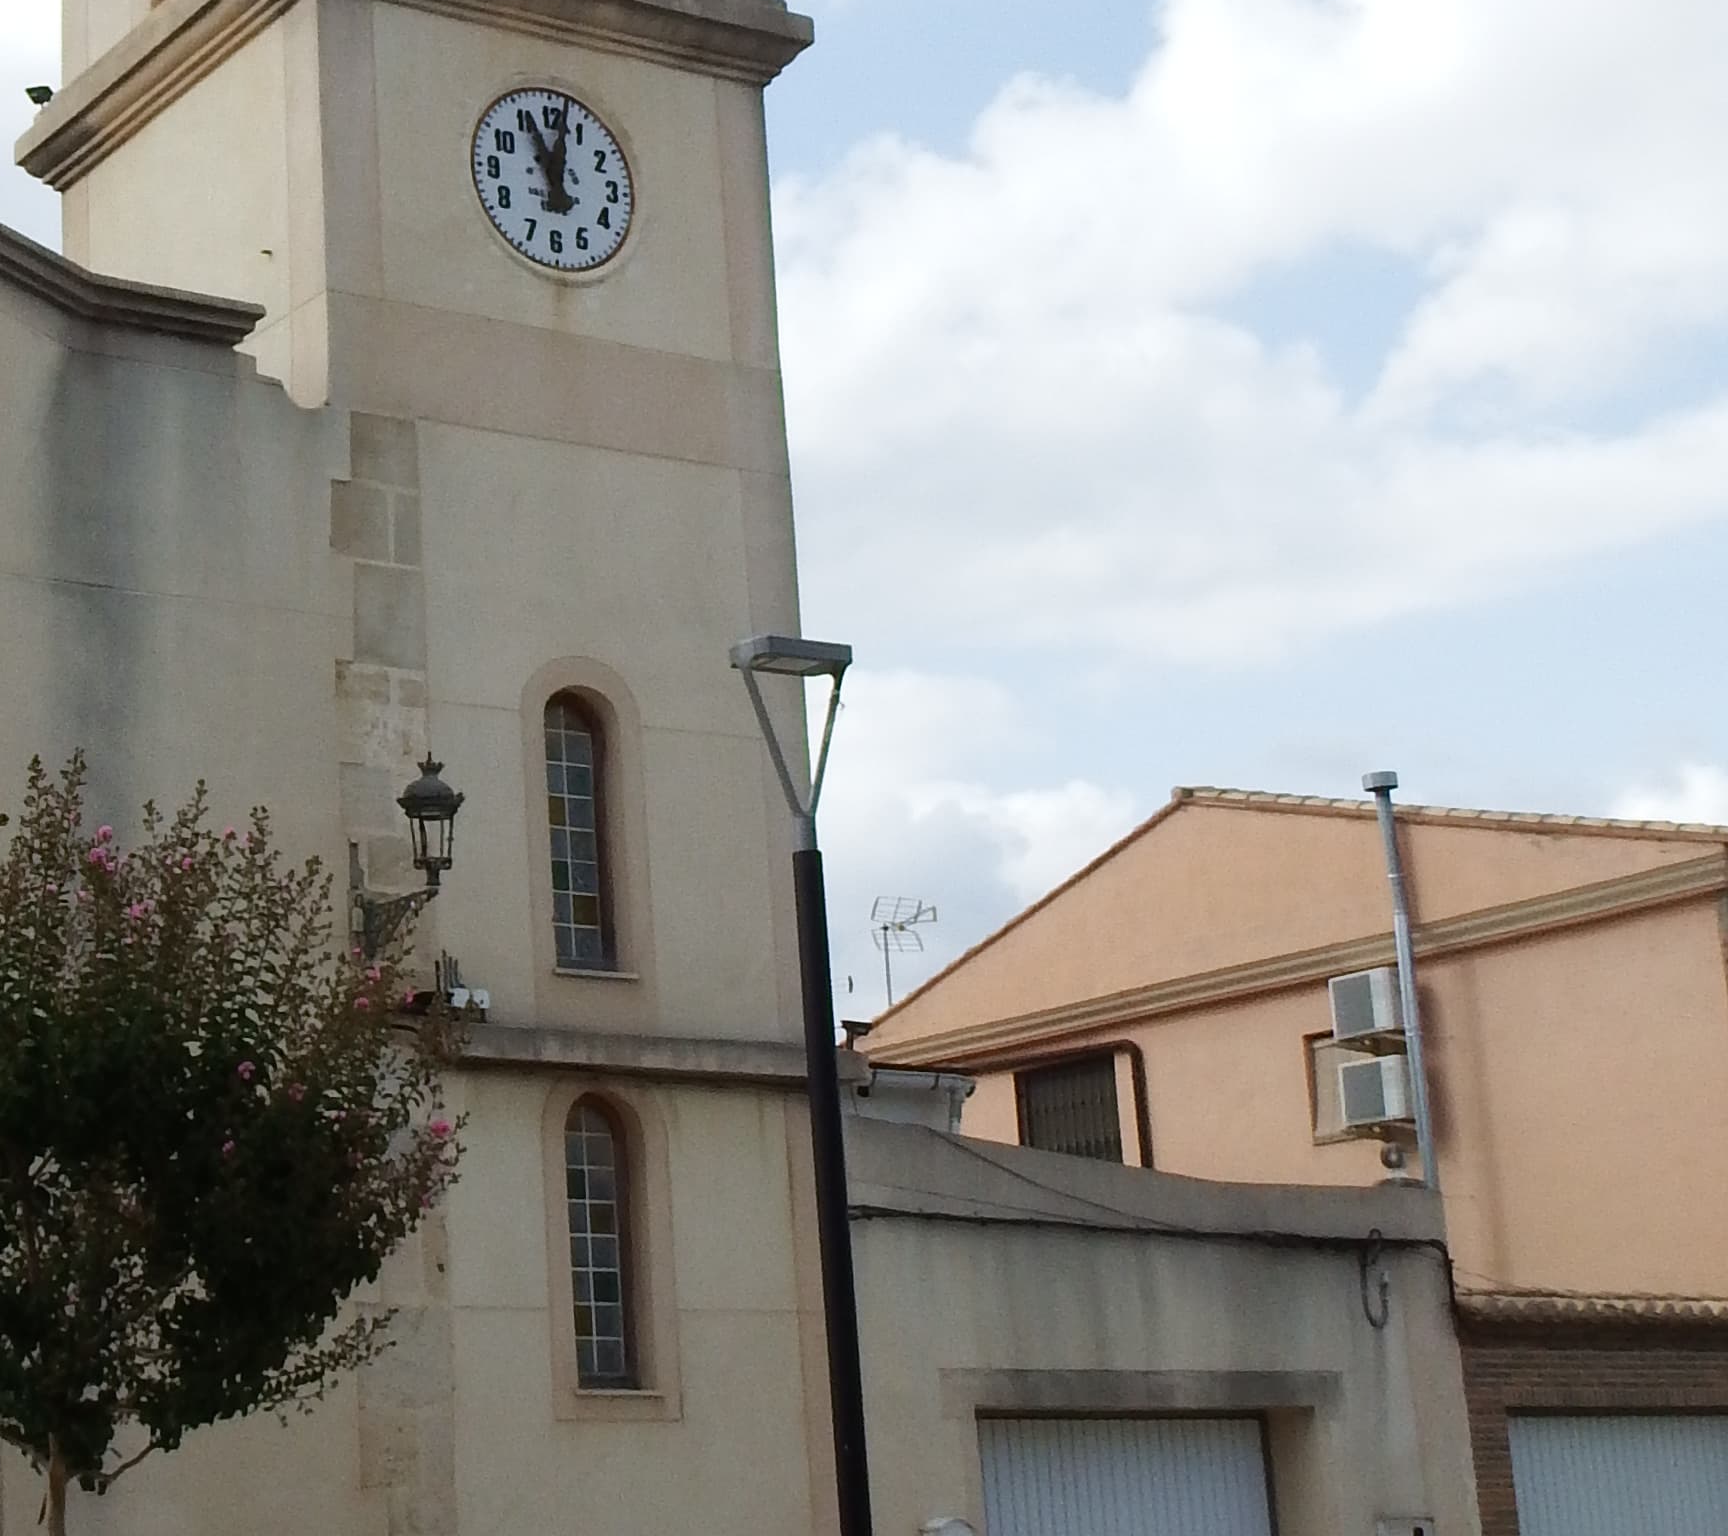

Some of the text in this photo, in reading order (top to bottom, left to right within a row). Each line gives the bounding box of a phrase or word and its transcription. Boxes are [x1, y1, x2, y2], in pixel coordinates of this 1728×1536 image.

[542, 105, 562, 130] 12
[494, 128, 515, 154] 10
[575, 122, 584, 146] 1
[487, 155, 500, 179] 9
[593, 150, 607, 174] 2
[497, 185, 511, 209] 8
[605, 180, 618, 204] 3
[524, 218, 537, 241] 7
[596, 207, 610, 230] 4
[549, 230, 563, 253] 6
[575, 226, 589, 250] 5
